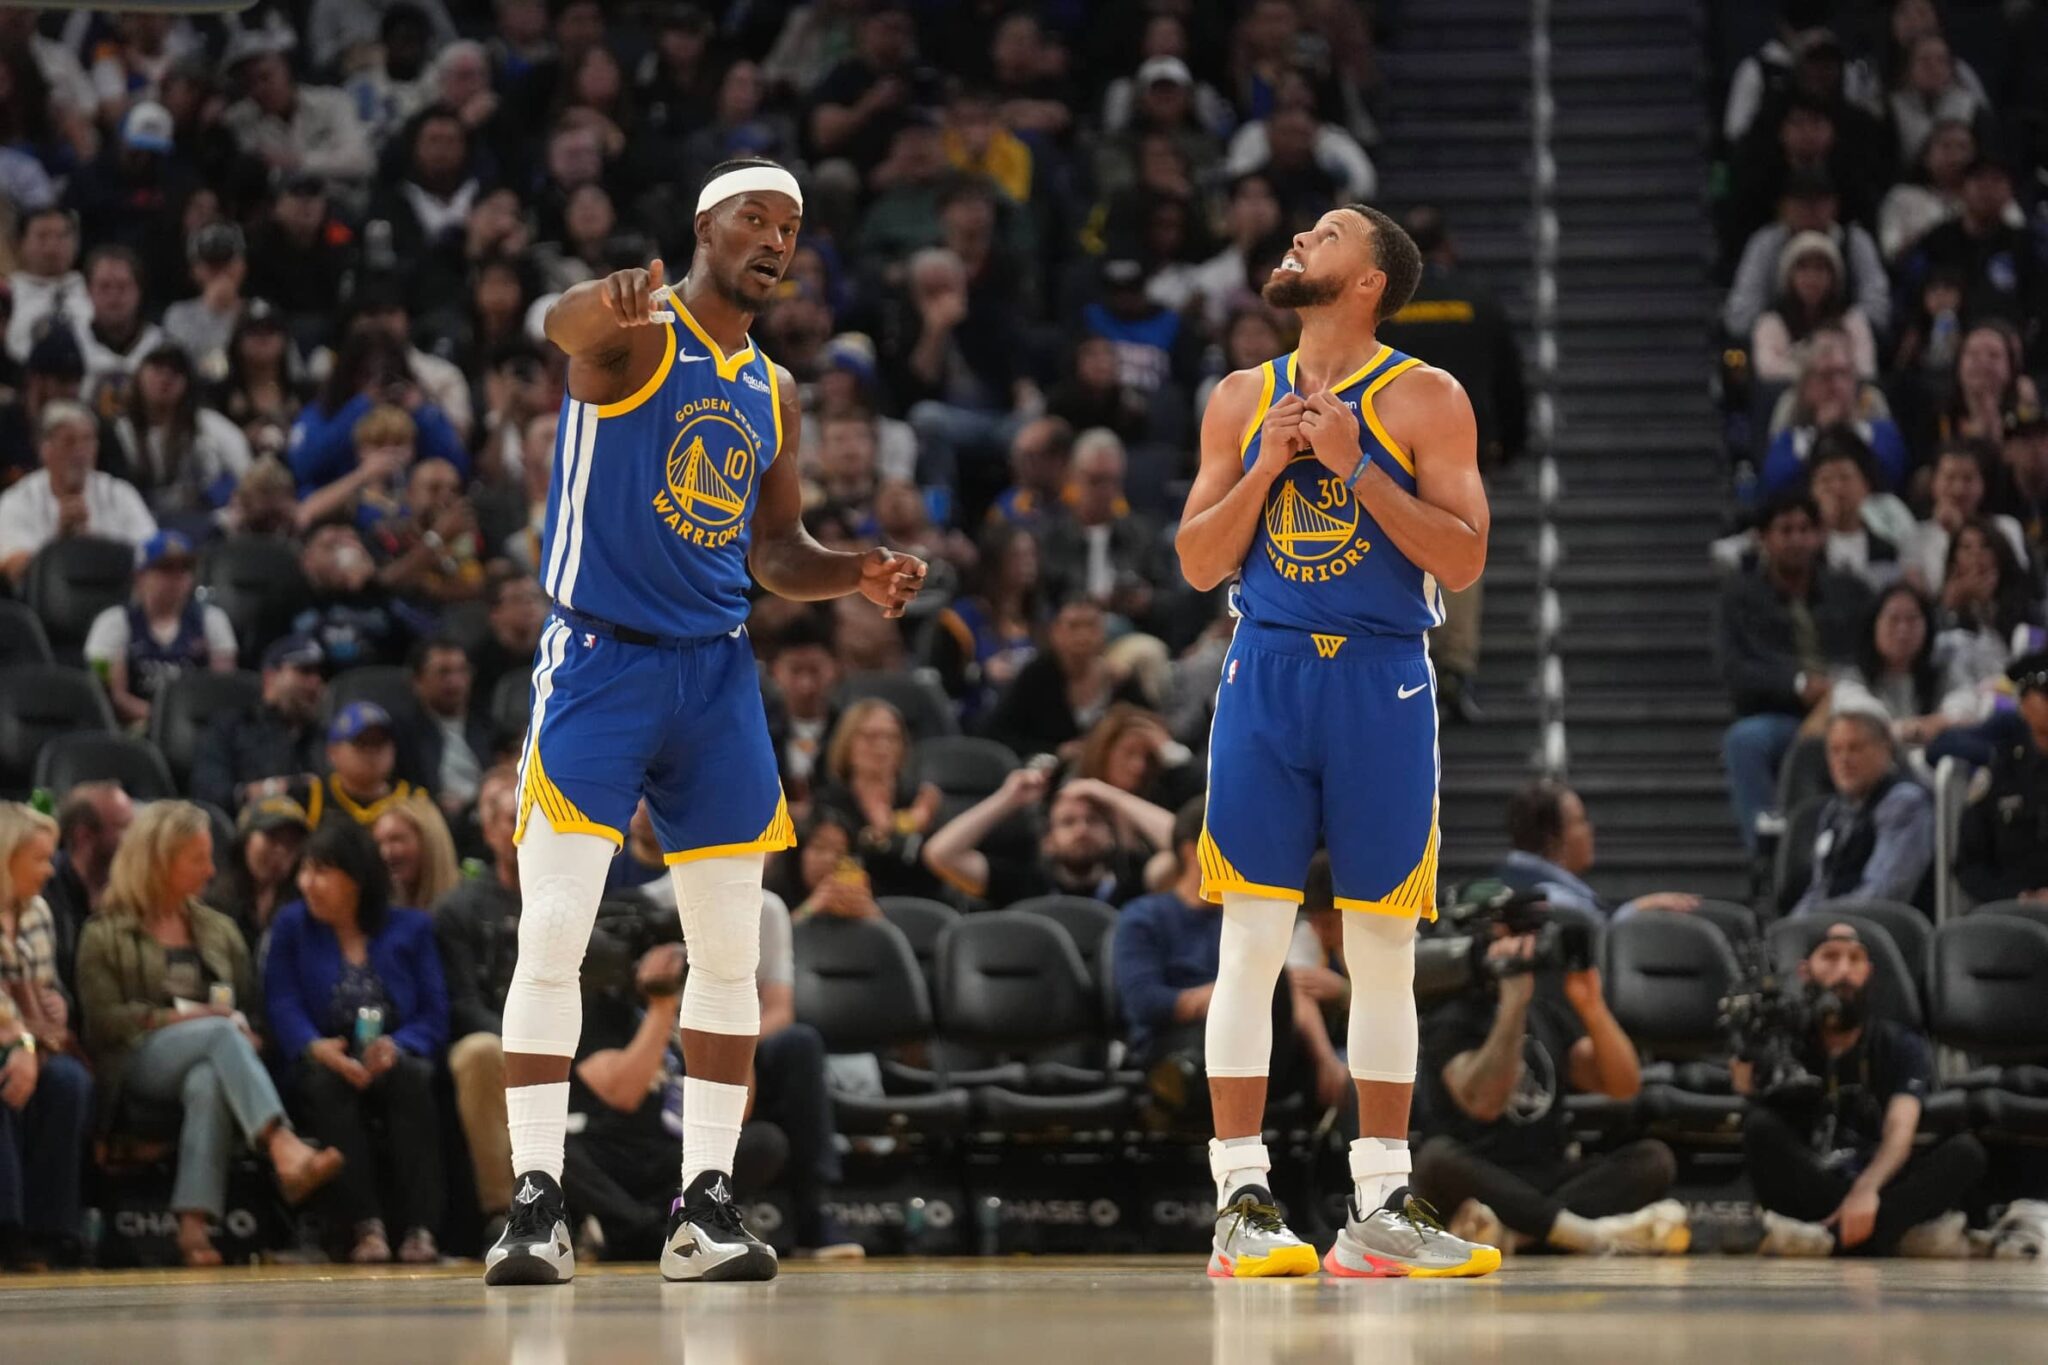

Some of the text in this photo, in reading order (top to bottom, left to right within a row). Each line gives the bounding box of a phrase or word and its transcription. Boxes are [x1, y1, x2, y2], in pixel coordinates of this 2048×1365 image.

[743, 371, 771, 395] Rakuten
[675, 398, 762, 450] GOLDEN STATE
[723, 447, 748, 480] 10
[1316, 477, 1348, 510] 30
[652, 489, 745, 548] WARRIORS
